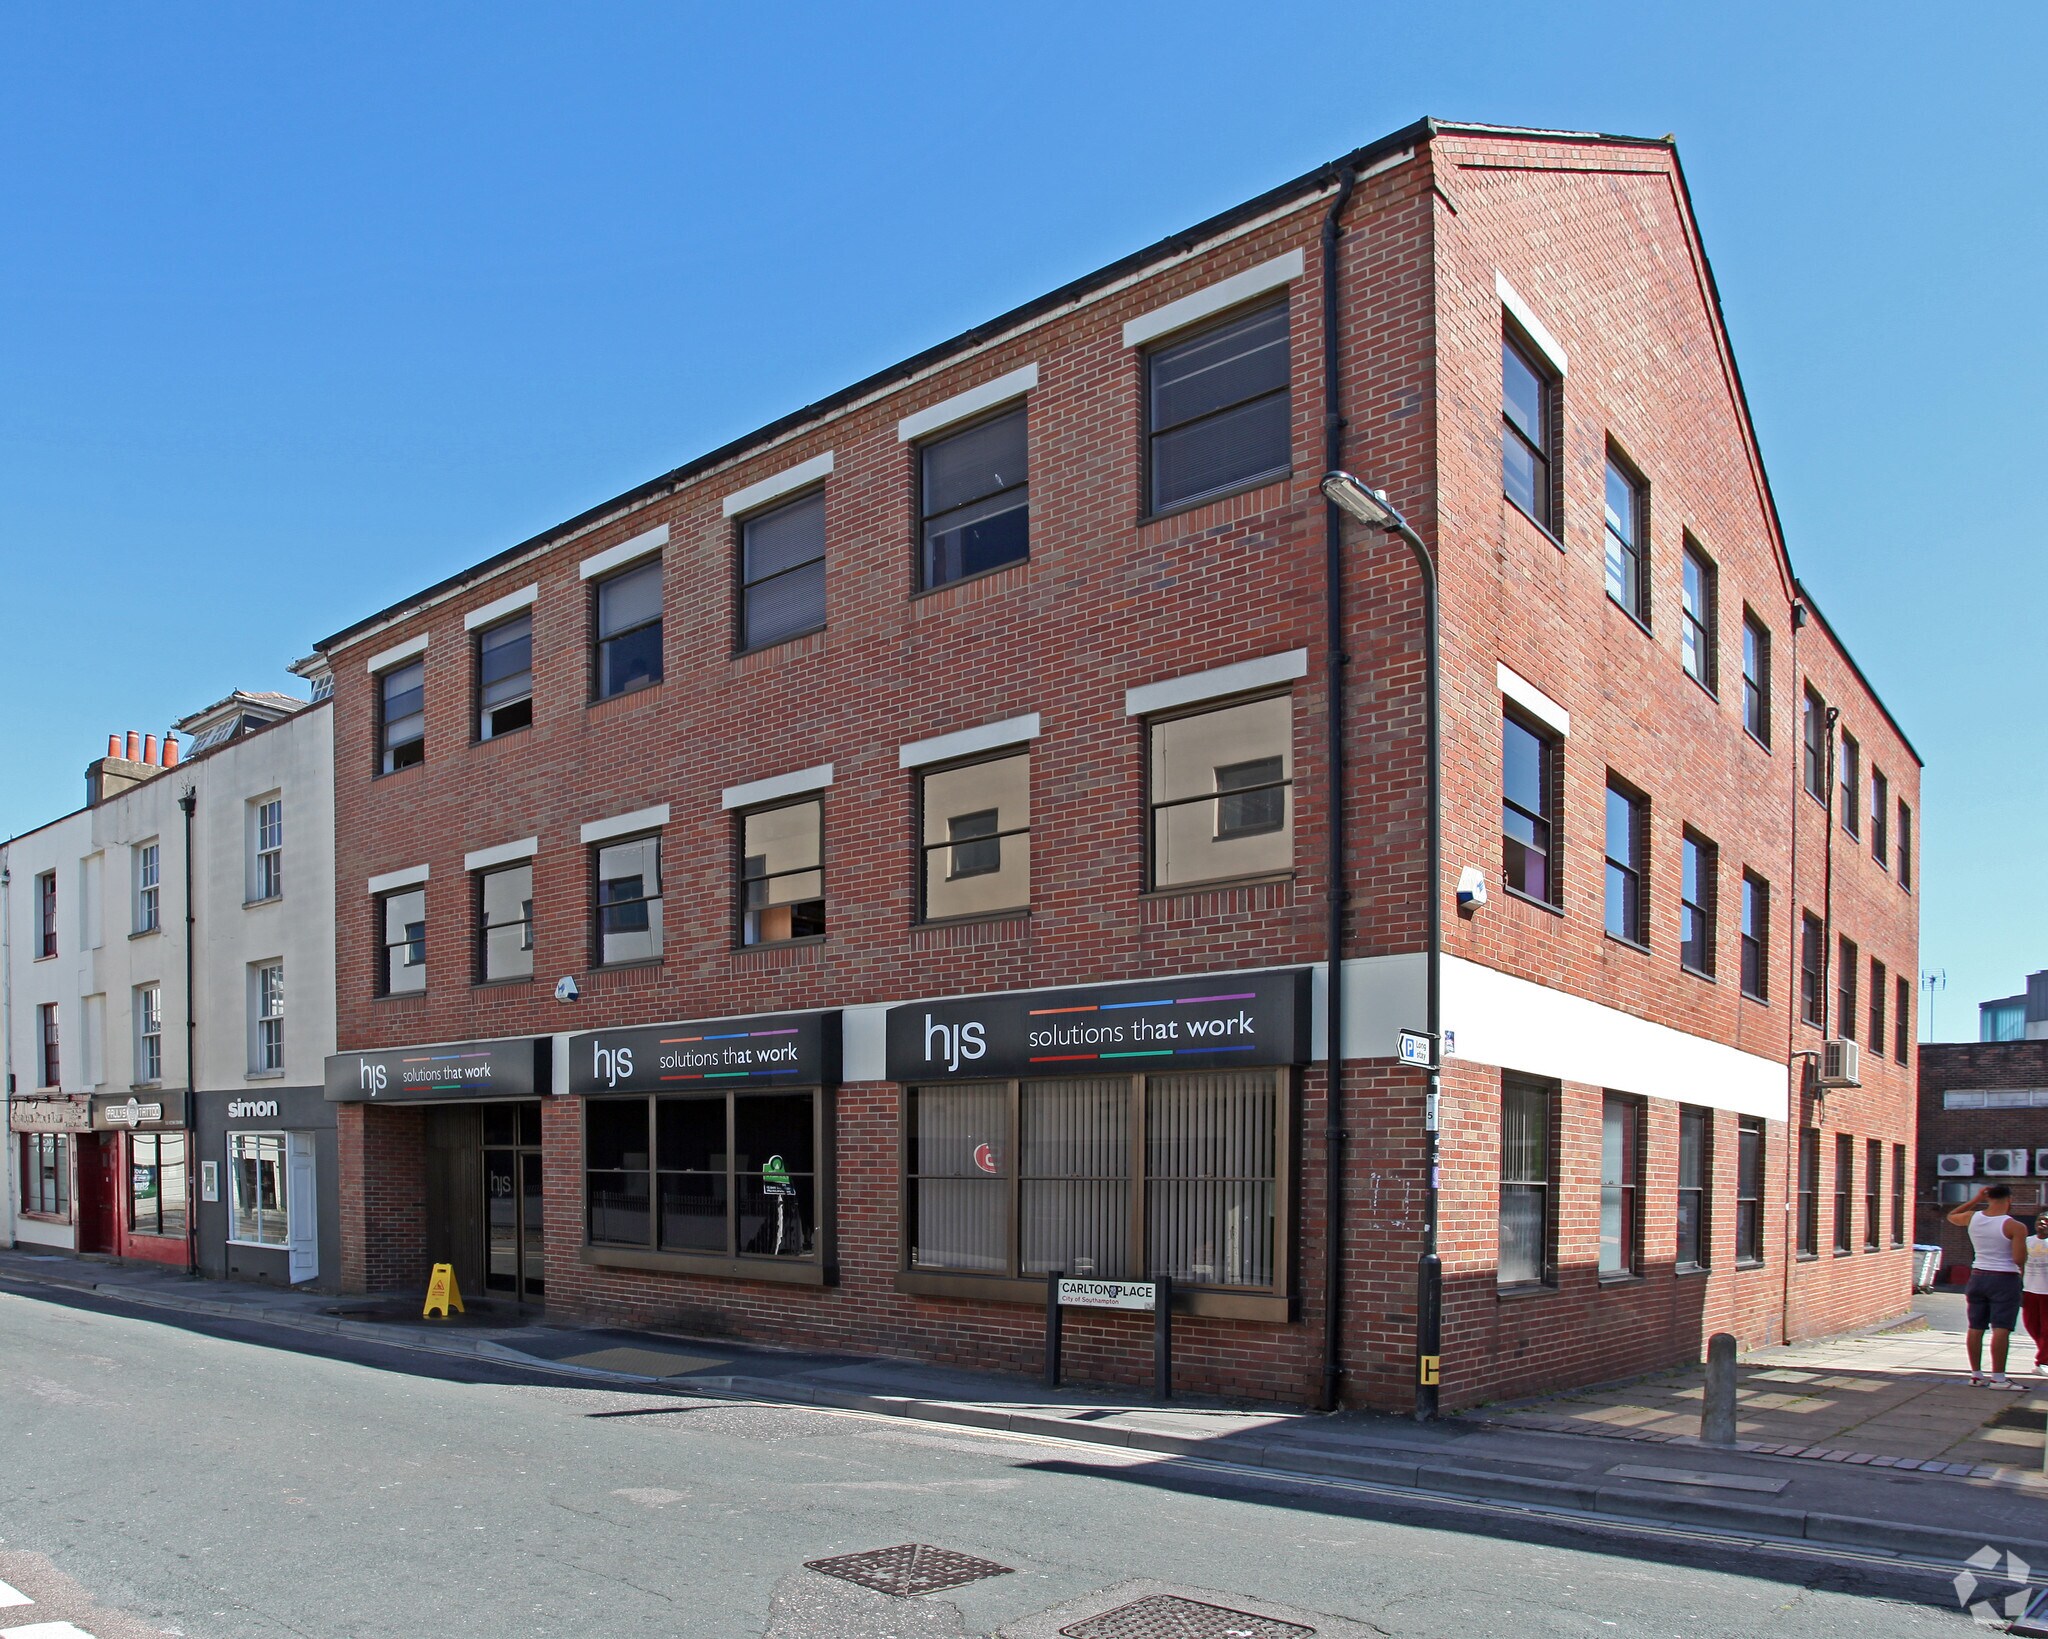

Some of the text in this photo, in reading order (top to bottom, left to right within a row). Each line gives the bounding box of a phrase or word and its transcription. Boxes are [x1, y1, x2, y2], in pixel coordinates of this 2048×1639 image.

[1029, 1010, 1255, 1048] solutions that work
[924, 1013, 987, 1072] hjs
[1416, 1038, 1427, 1052] Long
[593, 1040, 634, 1088] hjs
[659, 1041, 798, 1069] solutions that work
[1416, 1050, 1427, 1061] stay
[360, 1057, 388, 1097] hjs
[402, 1062, 491, 1083] solutions that work
[138, 1106, 160, 1117] TATTOO
[227, 1097, 278, 1118] simon
[1427, 1111, 1433, 1120] 5
[490, 1170, 511, 1197] hjs
[1062, 1282, 1153, 1298] CARLTON PLACE
[1062, 1295, 1073, 1303] City
[1082, 1296, 1120, 1305] Southampton
